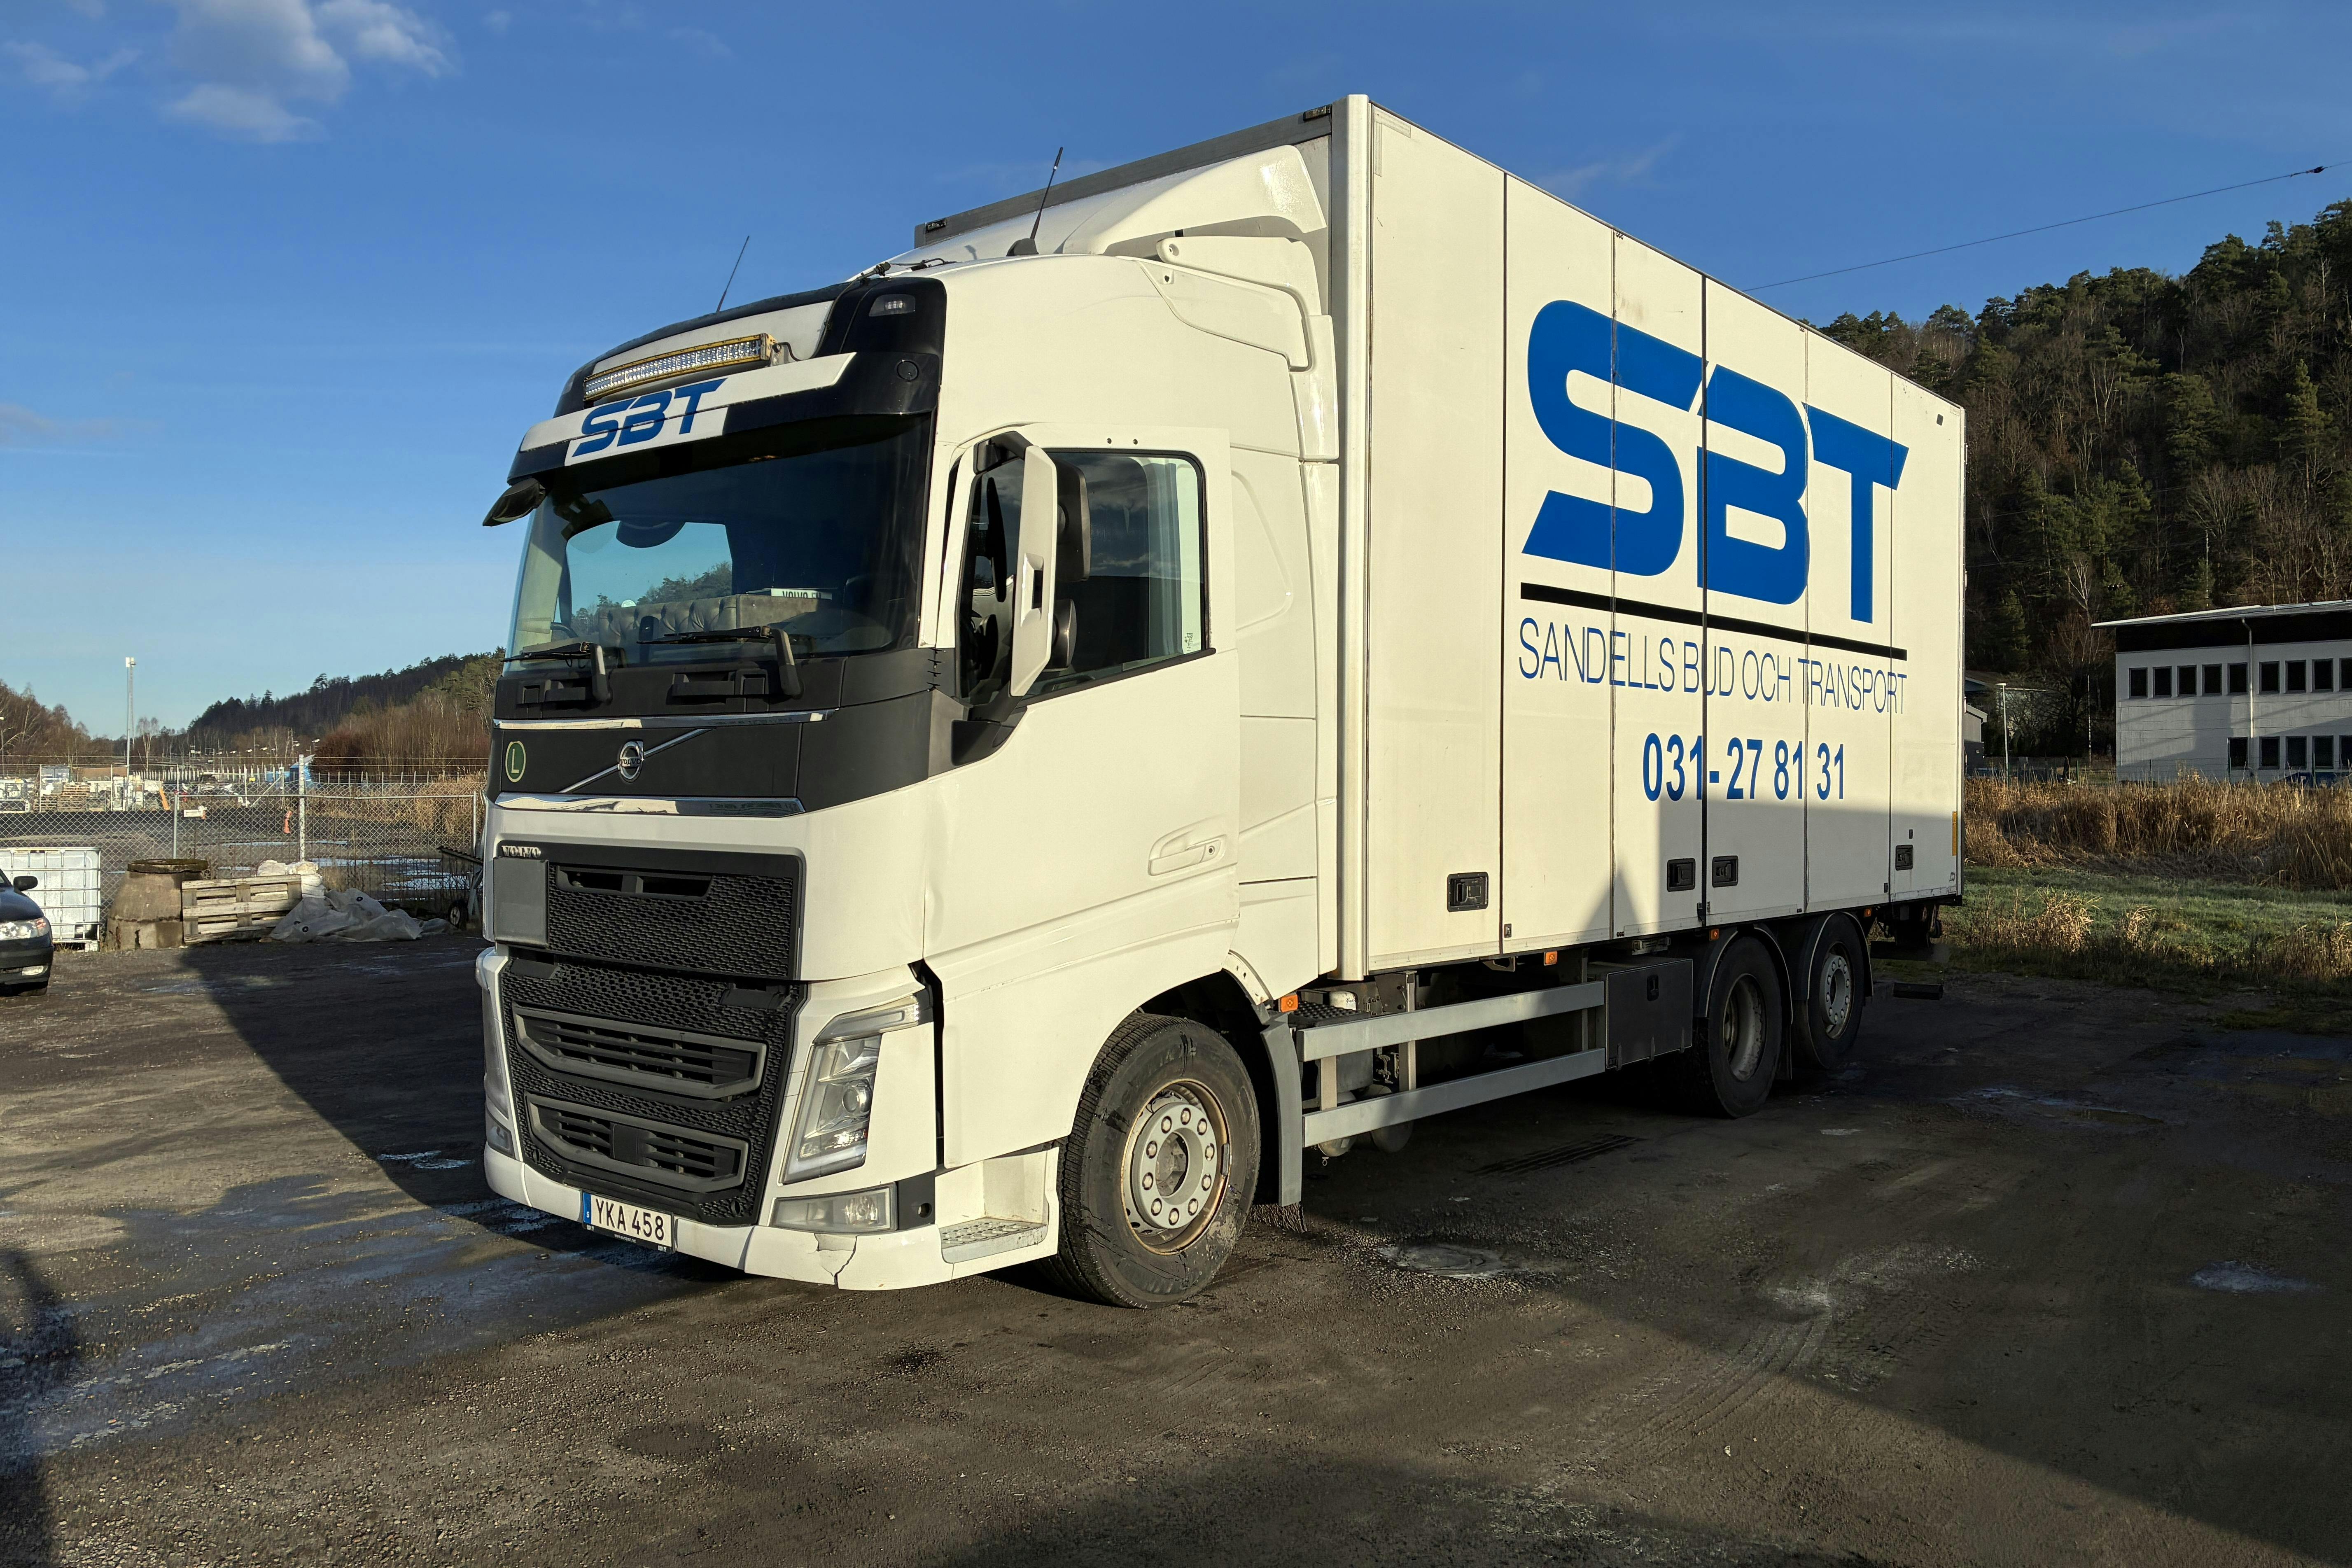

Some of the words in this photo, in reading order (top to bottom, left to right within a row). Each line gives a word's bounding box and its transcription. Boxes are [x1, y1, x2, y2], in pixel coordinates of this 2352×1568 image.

[572, 378, 728, 457] SBT
[1521, 300, 1909, 624] SBT
[1519, 617, 1675, 692] SANDELLS
[1684, 641, 1734, 696] BUD
[1742, 650, 1791, 703] OCH
[1798, 658, 1907, 714] TRANSPORT
[511, 749, 519, 773] L
[1774, 740, 1803, 800] 81
[1817, 742, 1843, 800] 31
[501, 845, 541, 858] VOLVO
[596, 1199, 626, 1231] YKA
[632, 1210, 664, 1241] 458
